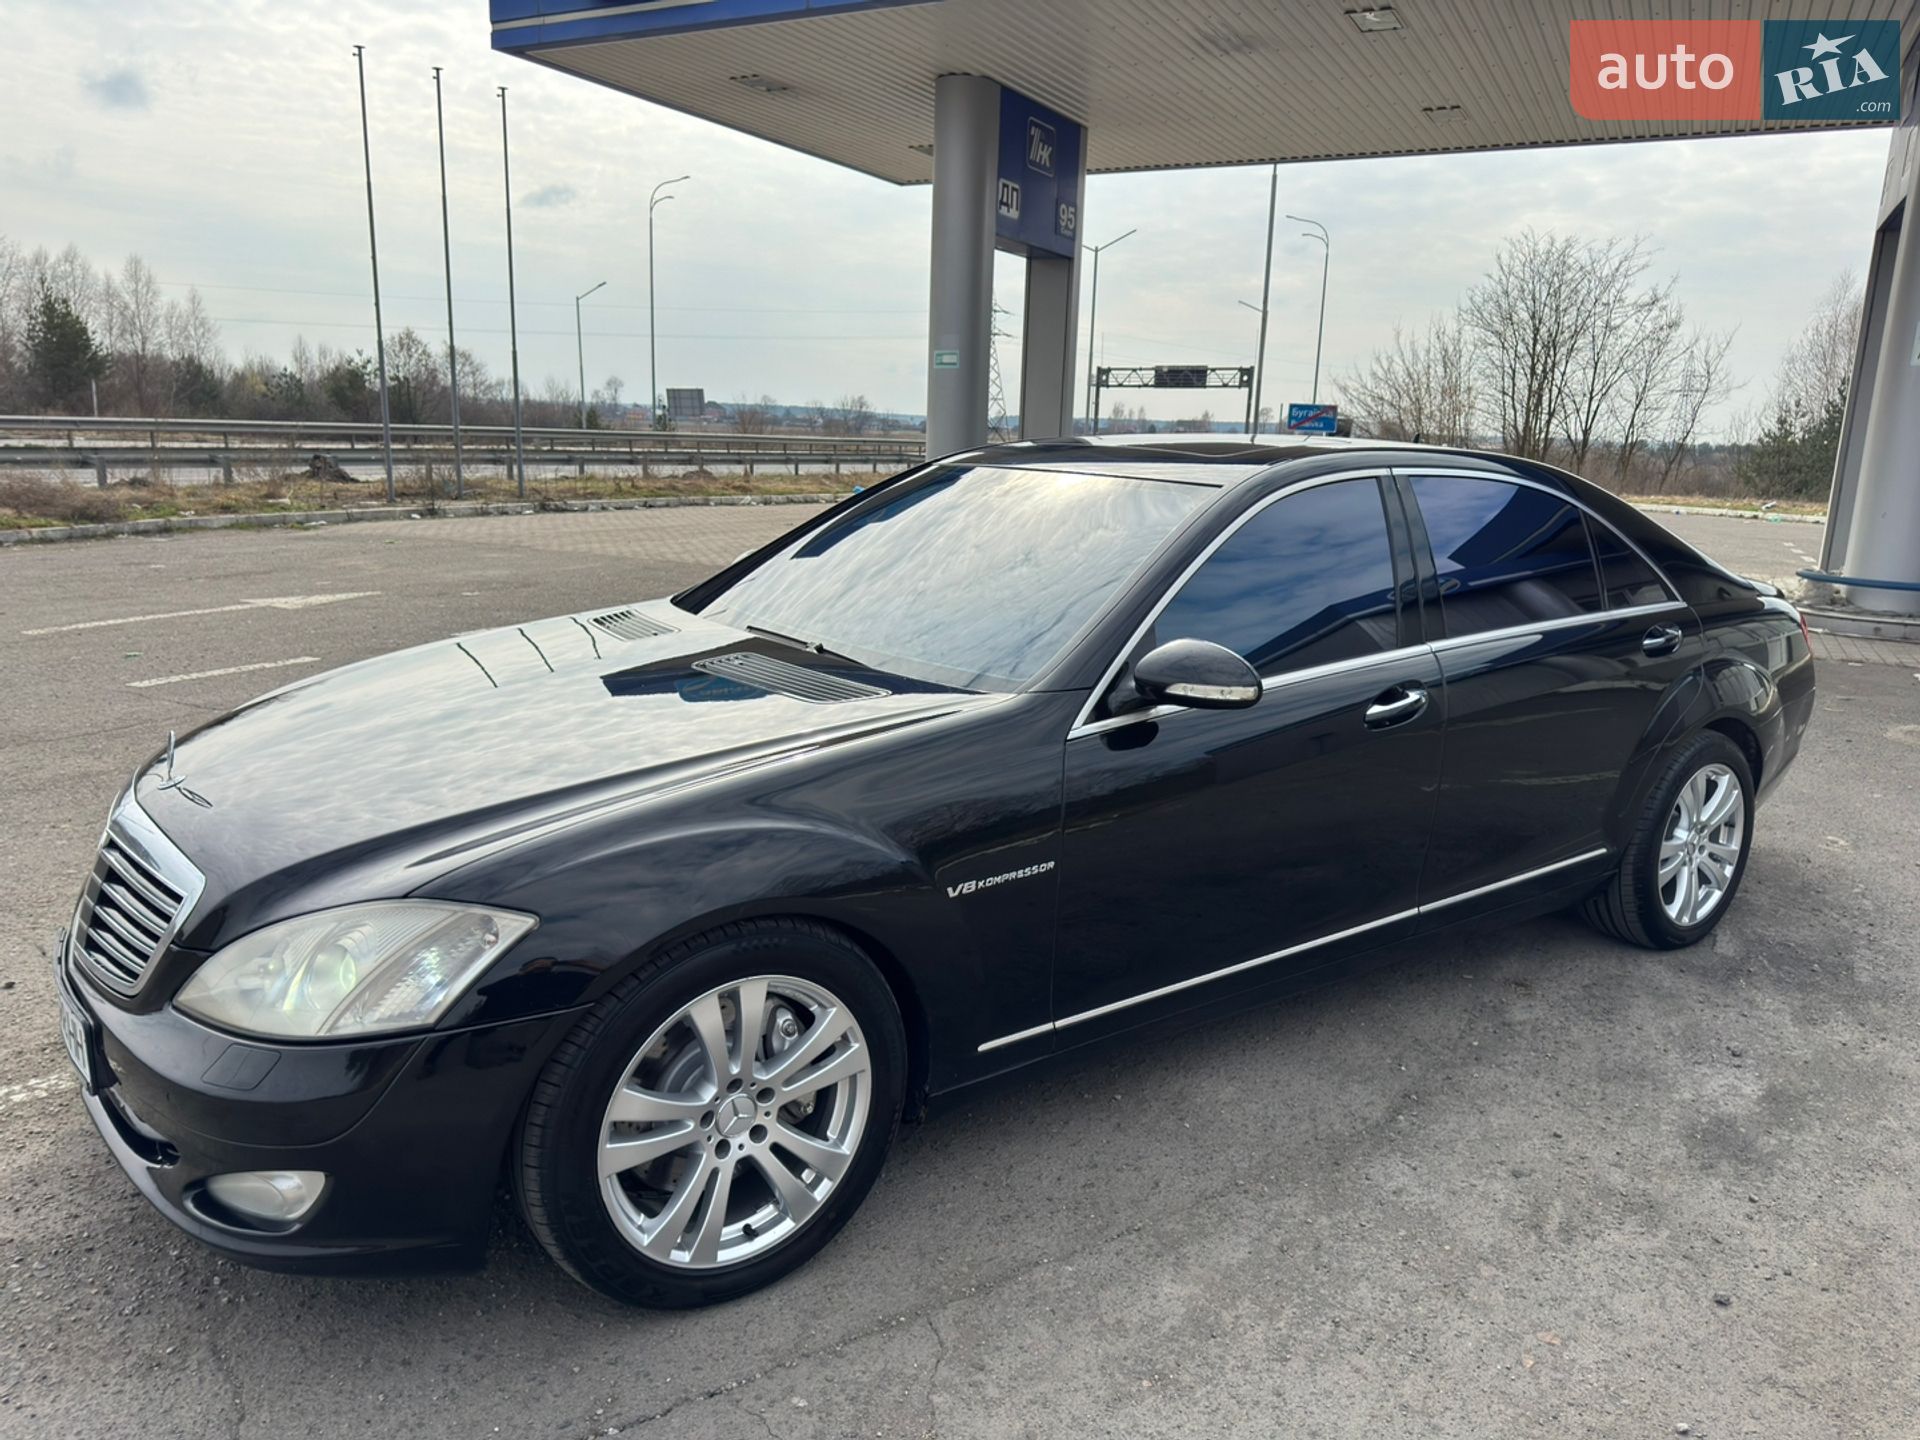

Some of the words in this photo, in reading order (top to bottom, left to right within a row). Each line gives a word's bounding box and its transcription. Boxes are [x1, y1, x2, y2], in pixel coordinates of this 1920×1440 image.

[999, 182, 1019, 213] ДП
[1059, 203, 1075, 230] 95
[947, 880, 976, 898] V8
[977, 861, 1055, 888] KOMPRESSOR
